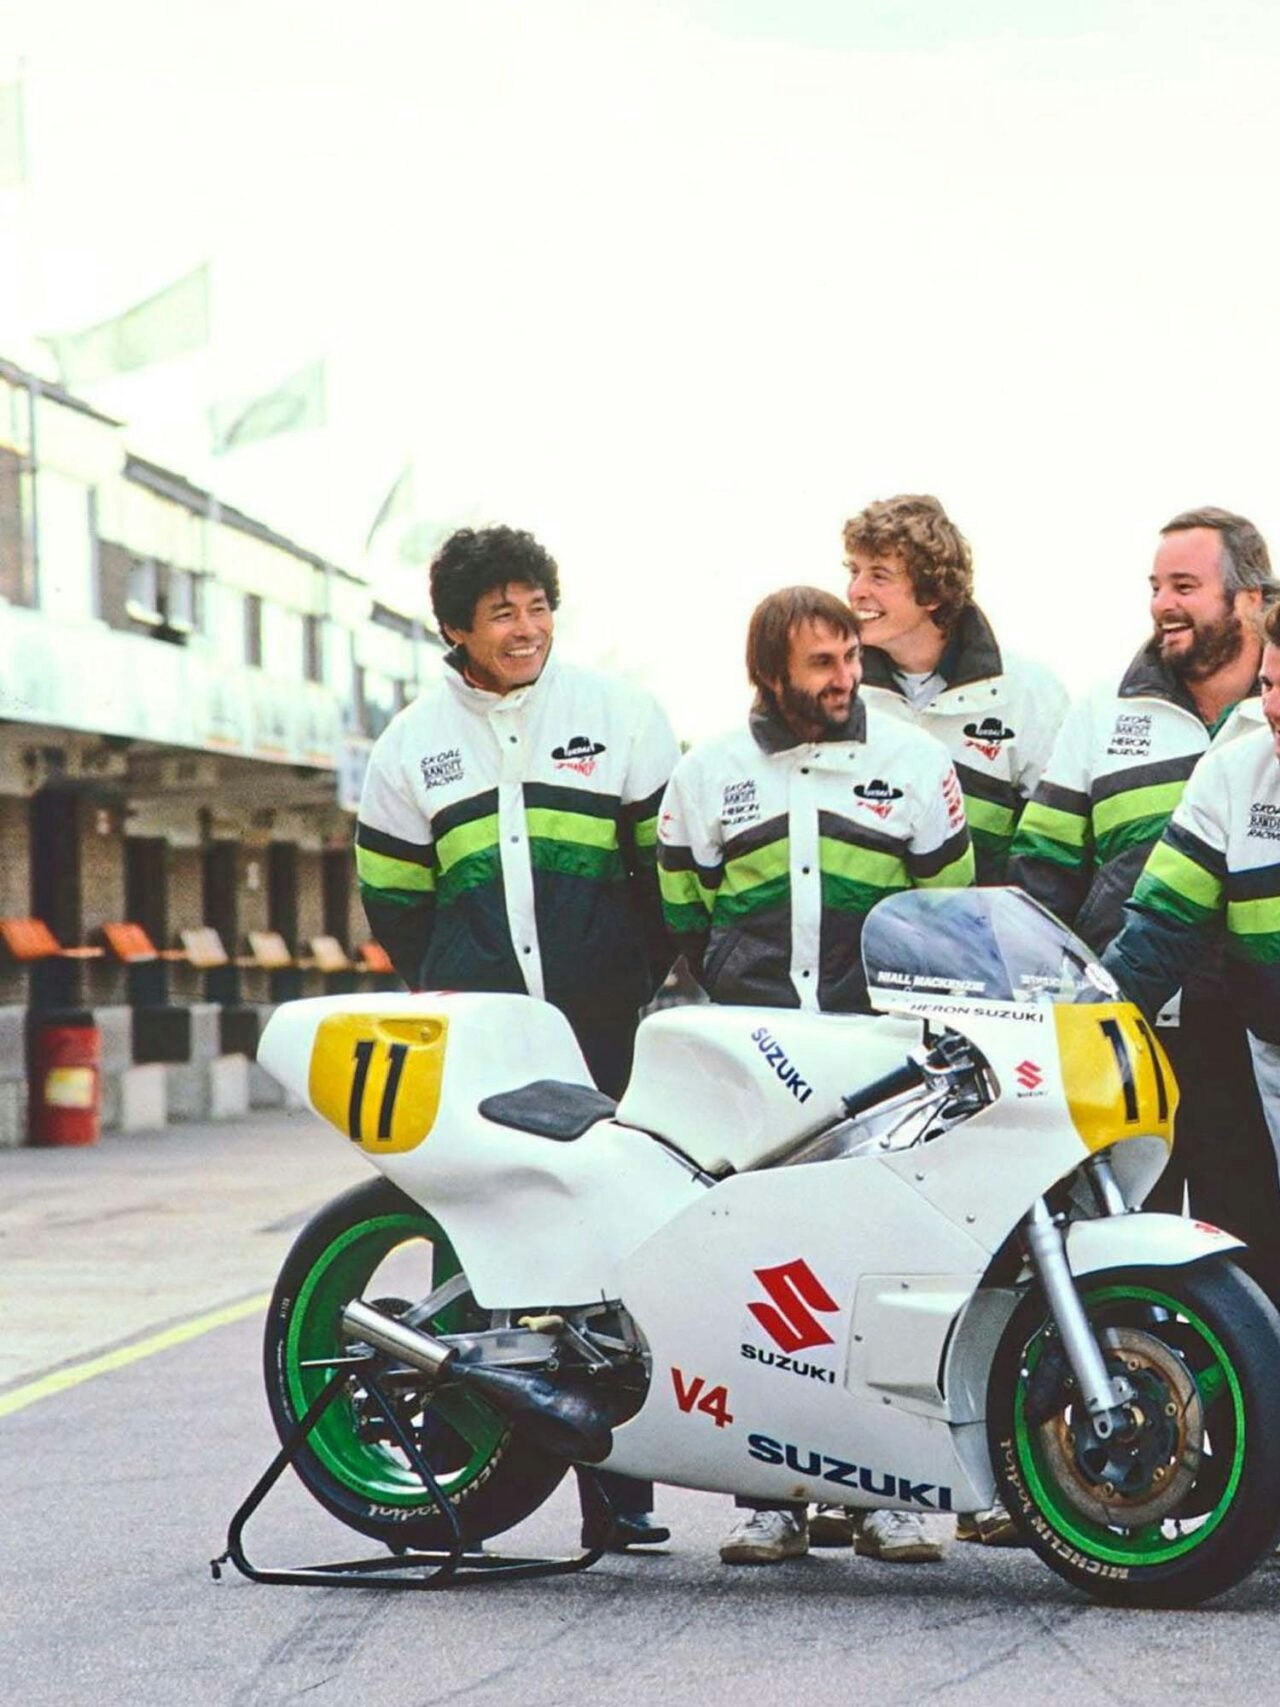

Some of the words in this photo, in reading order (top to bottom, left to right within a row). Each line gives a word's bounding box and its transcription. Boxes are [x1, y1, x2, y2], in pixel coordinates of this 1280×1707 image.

[876, 970, 912, 986] NIALL
[911, 1003, 970, 1015] HERON
[973, 1007, 1044, 1024] SUZUKI
[348, 1040, 409, 1142] 11
[751, 1026, 814, 1104] SUZUKI
[1097, 1017, 1169, 1124] 11
[740, 1343, 835, 1384] SUZUKI
[671, 1367, 733, 1428] V4
[747, 1433, 953, 1511] SUZUKI
[1031, 1515, 1129, 1579] MICHELIN
